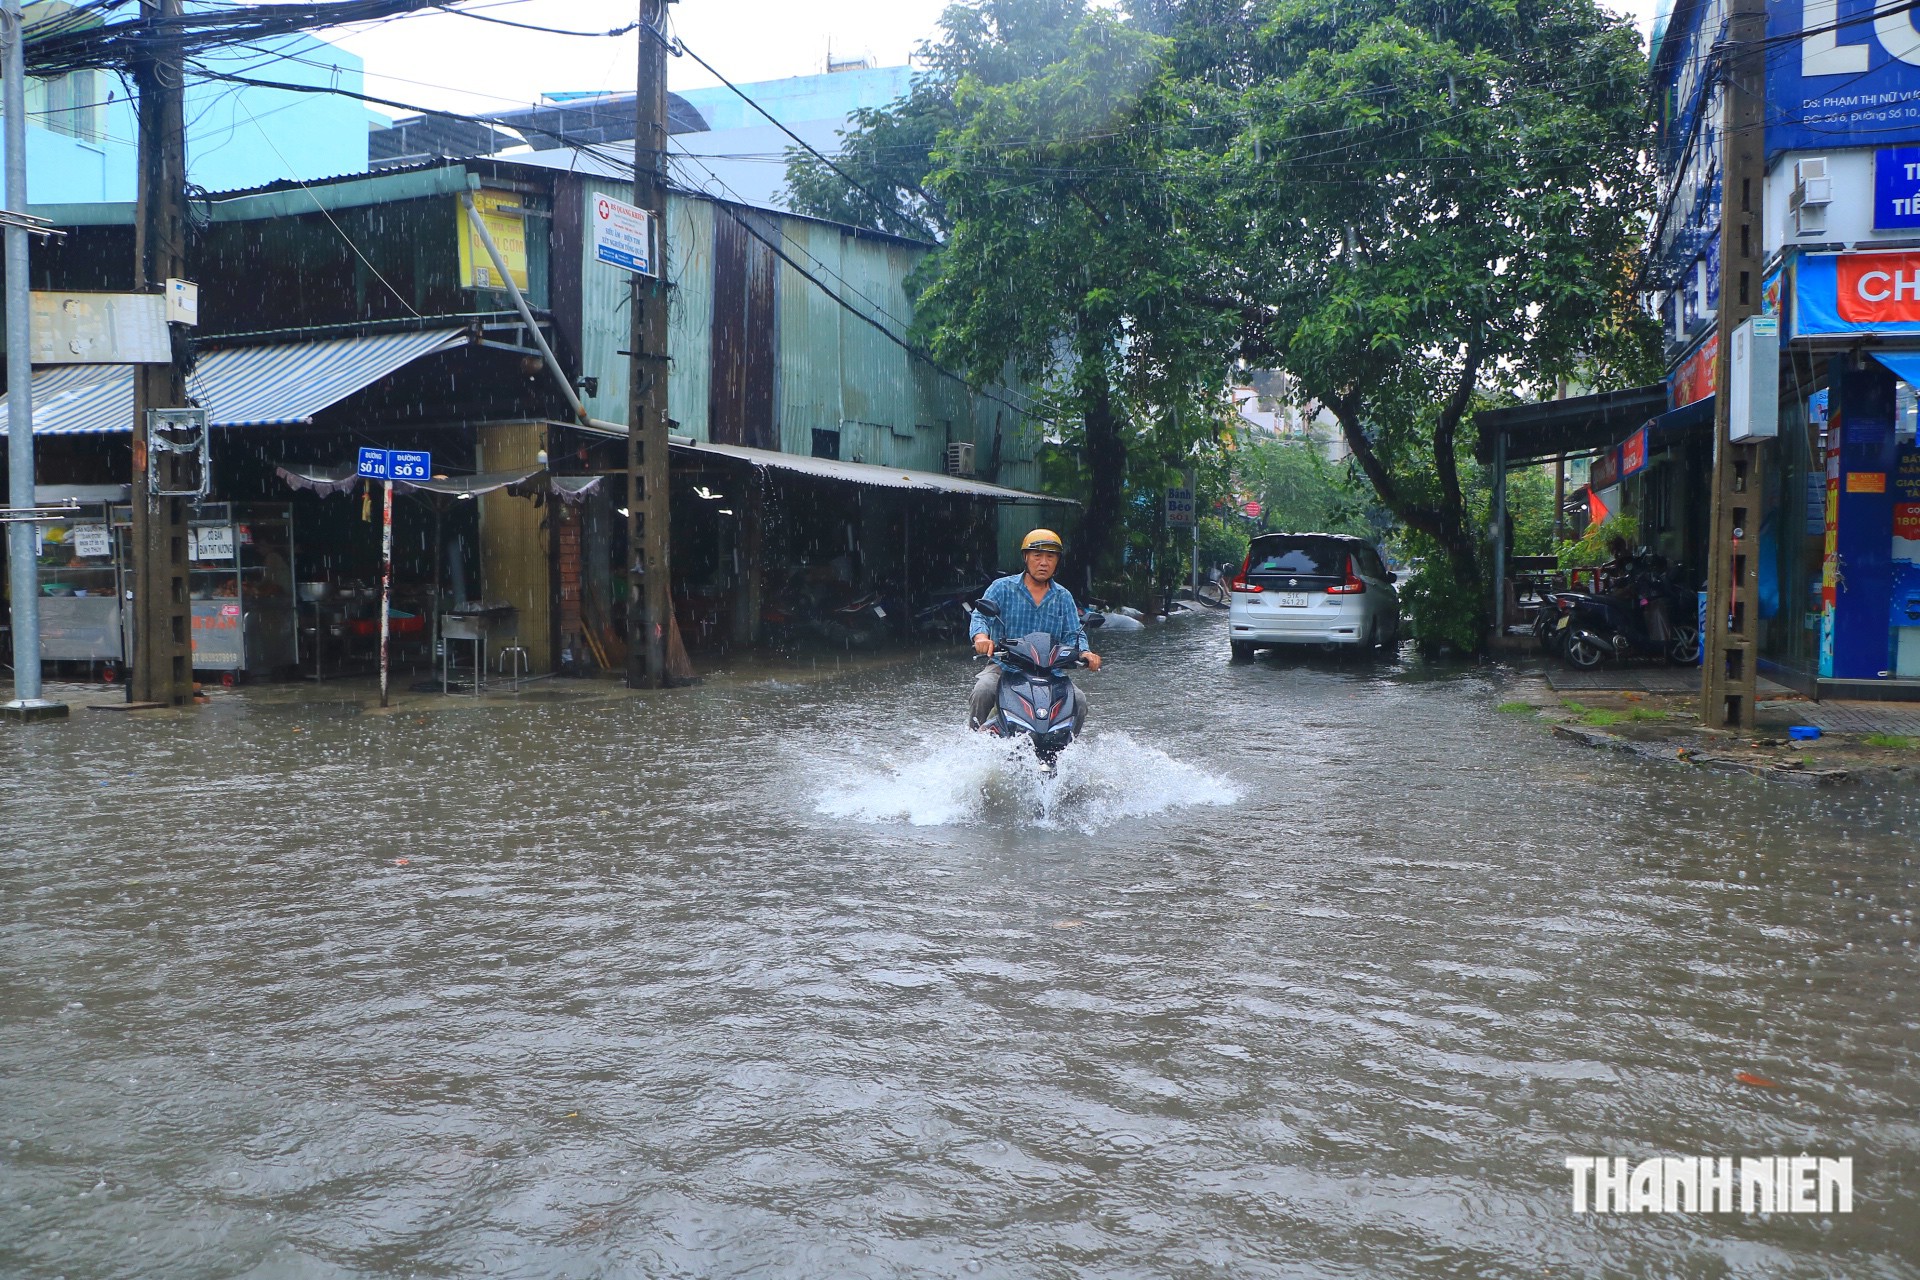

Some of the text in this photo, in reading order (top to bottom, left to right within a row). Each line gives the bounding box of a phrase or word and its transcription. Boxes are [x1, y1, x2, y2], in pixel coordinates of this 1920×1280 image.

[1803, 99, 1820, 108] DS:
[1824, 96, 1857, 108] PHẠM
[1860, 94, 1876, 106] THỊ
[1880, 92, 1898, 103] NỮ
[1851, 112, 1886, 121] Đường
[1888, 108, 1902, 118] Số
[474, 234, 502, 250] QN
[1858, 270, 1920, 301] CH
[365, 451, 382, 460] ĐƯỜNG
[397, 454, 421, 462] ĐƯỜNG
[360, 460, 384, 474] SỐ 10
[395, 463, 424, 476] SỐ 9
[1168, 500, 1192, 512] Bèo
[1896, 517, 1920, 526] 180
